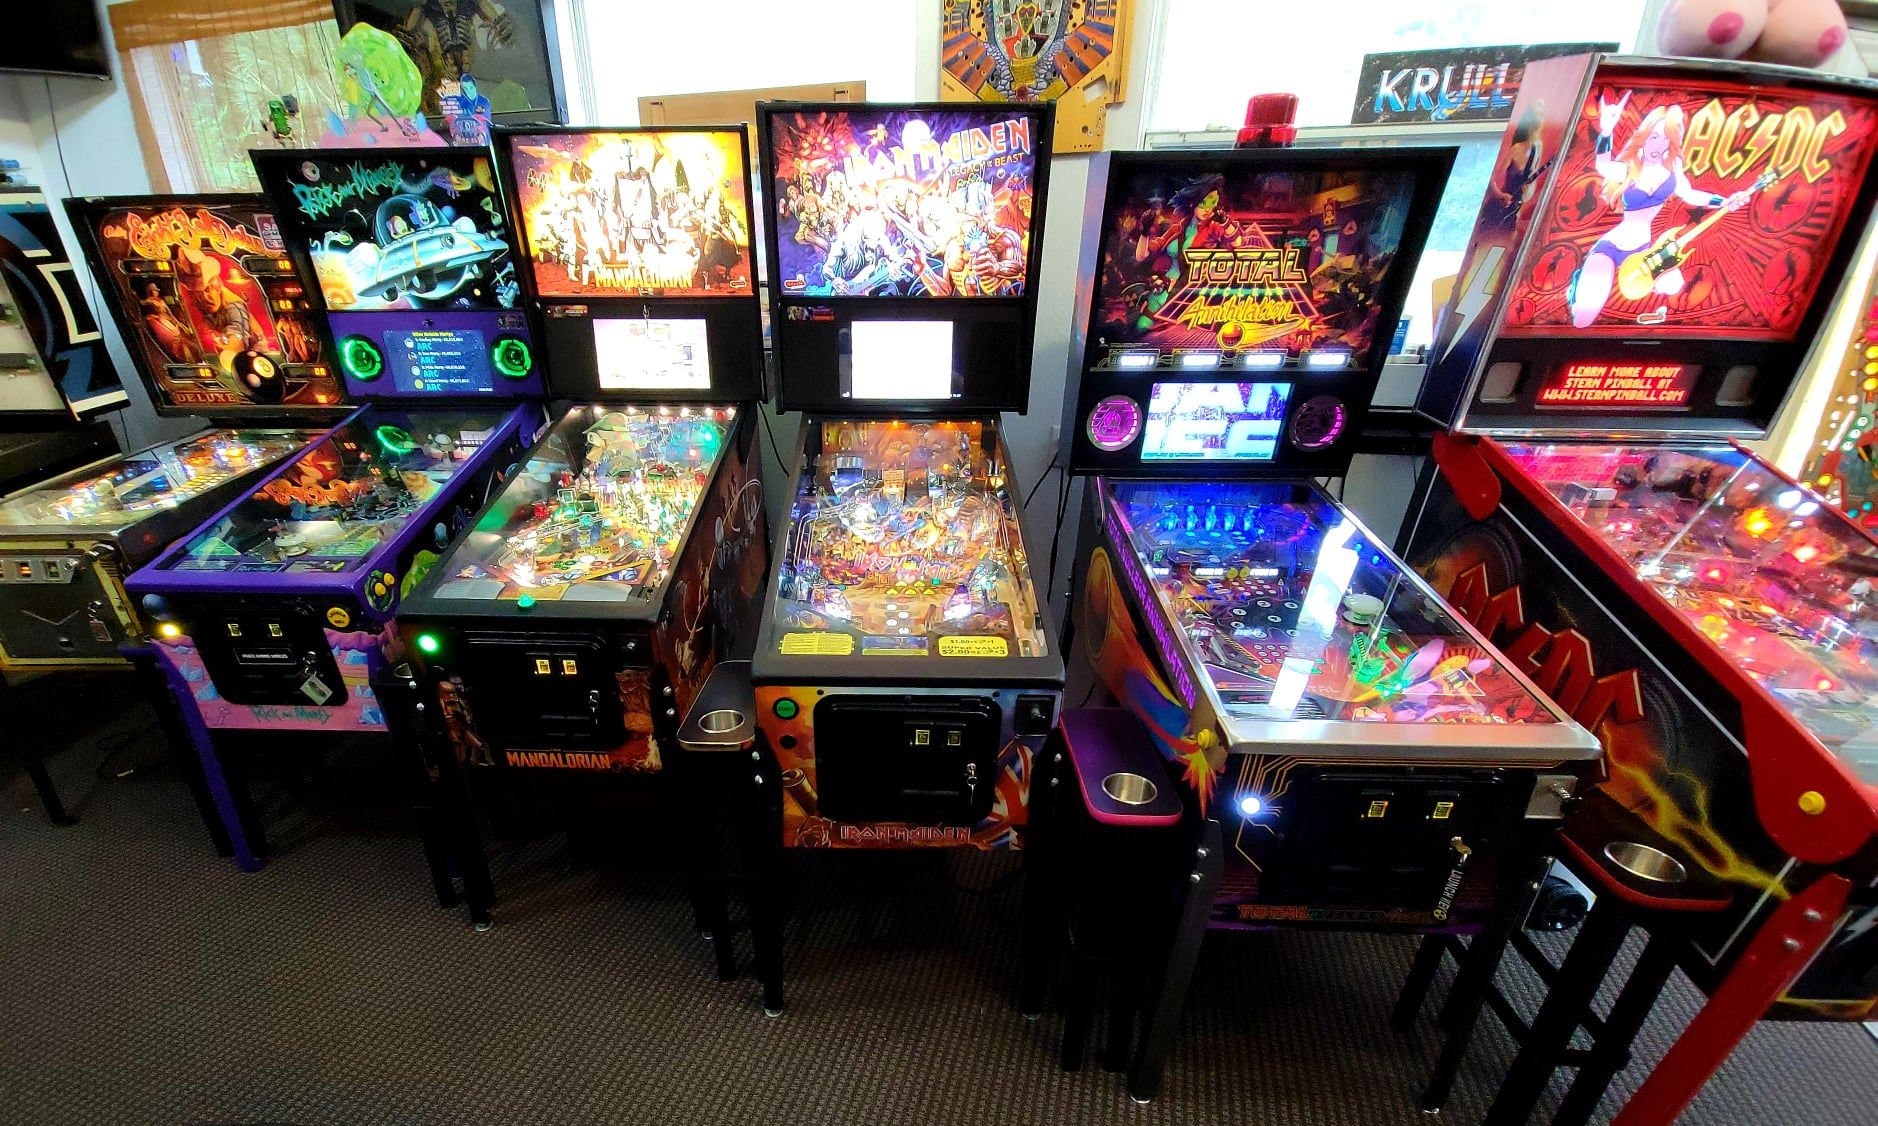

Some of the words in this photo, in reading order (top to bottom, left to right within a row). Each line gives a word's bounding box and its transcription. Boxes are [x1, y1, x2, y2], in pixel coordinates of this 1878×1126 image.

[1374, 63, 1513, 121] KRULL
[911, 117, 1030, 170] MAIDEN
[1681, 99, 1847, 184] AC/DC
[949, 160, 985, 179] LEGACY
[994, 153, 1024, 167] BEAST
[1184, 249, 1307, 283] TOTAL
[594, 267, 693, 288] MANDALORIAN
[1178, 296, 1305, 330] Annihilation
[259, 361, 271, 372] 8
[1568, 366, 1607, 377] LEARN
[1609, 366, 1642, 377] MORE
[1643, 367, 1681, 378] ABOUT
[1564, 378, 1602, 388] STERN
[1604, 378, 1652, 389] PINBALL
[1656, 379, 1673, 389] AT
[176, 392, 236, 402] DELUXE
[1543, 389, 1685, 401] WWW.STERNPINBALL.COM
[506, 752, 611, 769] MANDALORIAN
[841, 825, 891, 843] IRON
[894, 826, 971, 843] MAIDEN
[1443, 869, 1464, 898] LAUNCH
[1239, 904, 1311, 921] TOTAL
